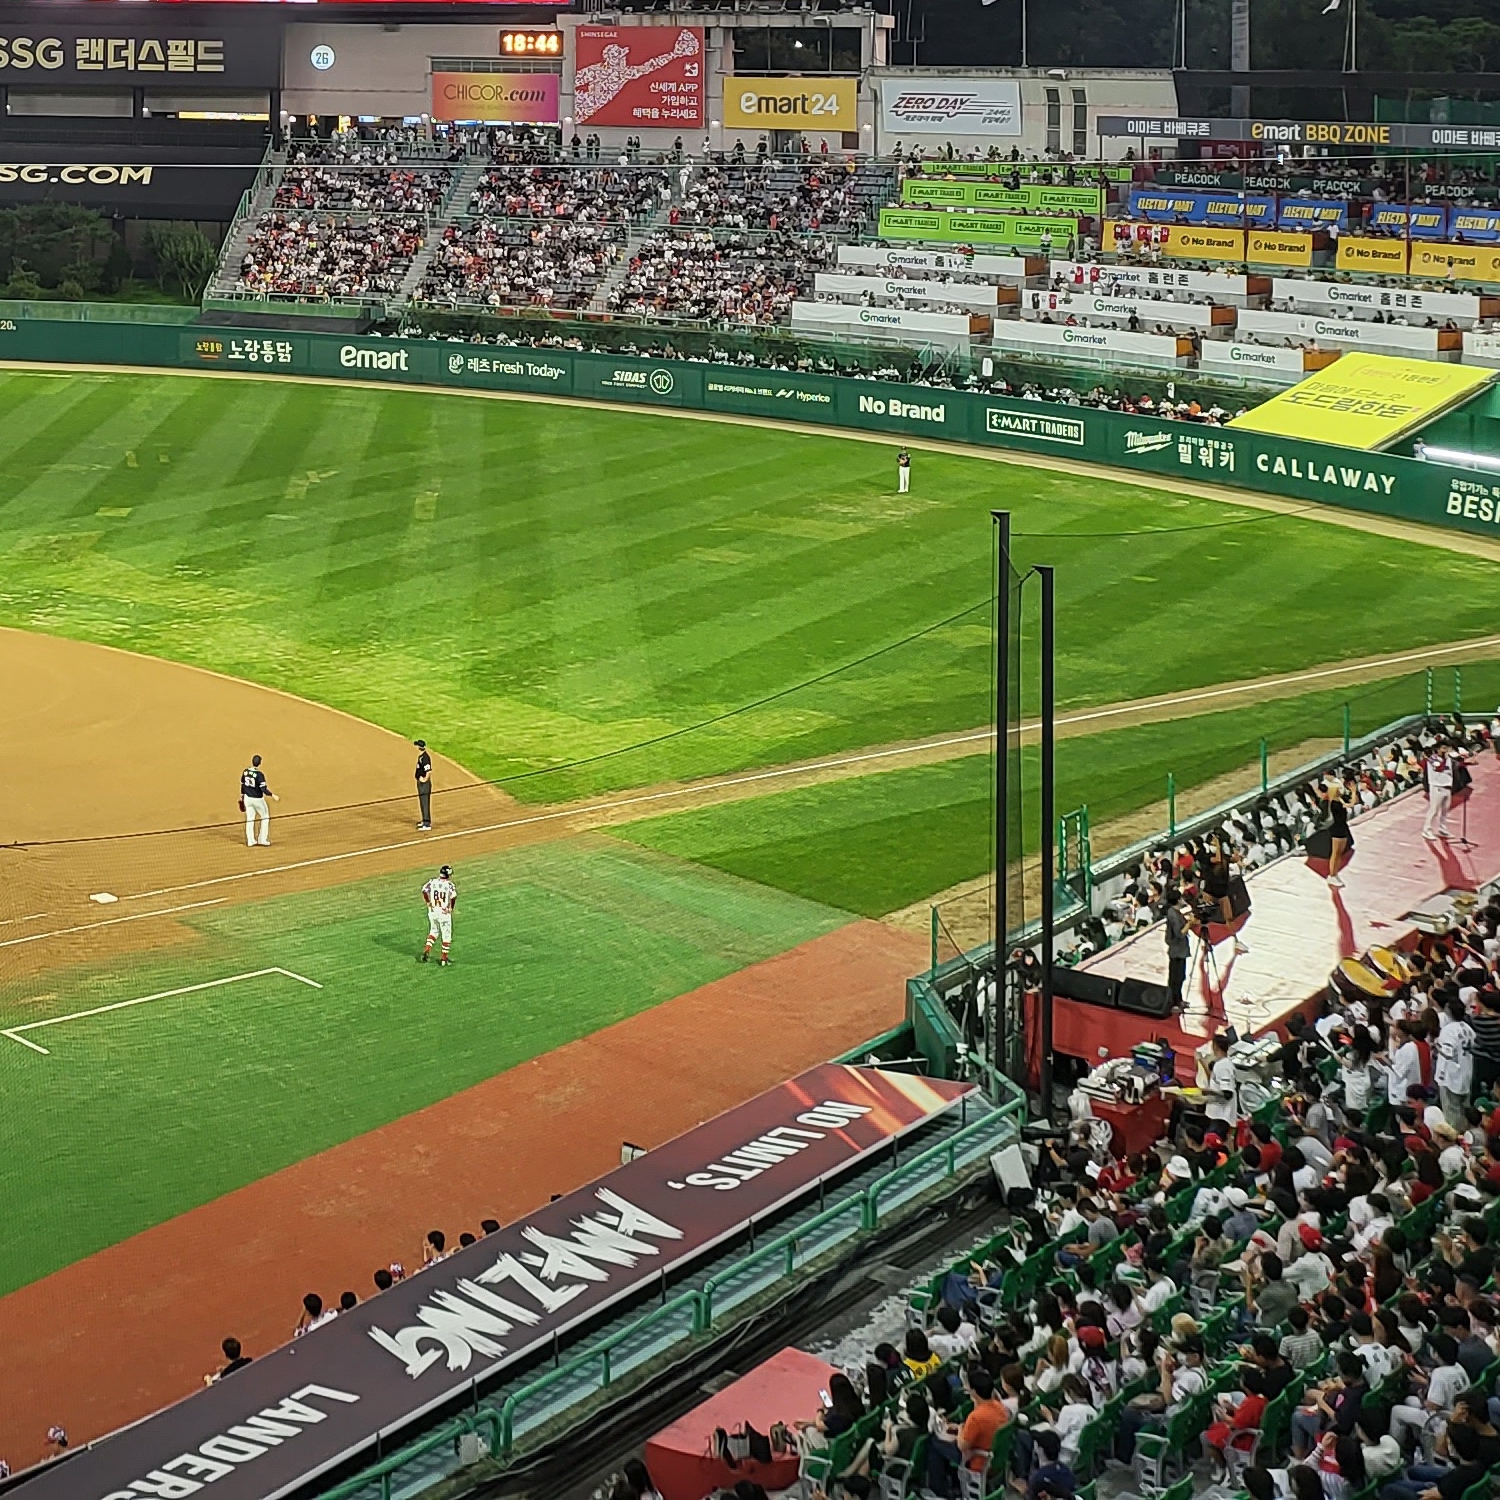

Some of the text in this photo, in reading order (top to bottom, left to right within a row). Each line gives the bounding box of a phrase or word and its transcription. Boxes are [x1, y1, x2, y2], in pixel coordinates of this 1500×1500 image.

[503, 33, 559, 53] 18:44
[75, 37, 225, 73] 랜더스필드
[315, 51, 330, 66] 26
[443, 83, 547, 103] CHICOR.com
[649, 82, 699, 93] 신세계 APP
[661, 95, 699, 107] 가입하고
[892, 96, 971, 110] ZERO DAY
[661, 108, 699, 119] 누리세요
[1127, 120, 1211, 136] 이마트 바베큐존
[1251, 122, 1391, 145] emart BBQ ZONE
[1432, 128, 1469, 145] 이마트
[1174, 172, 1221, 186] PEACOCK
[1425, 184, 1476, 198] PEACOCK
[1206, 238, 1235, 247] Brand
[1278, 243, 1306, 253] Brand
[886, 251, 928, 266] Gmarket
[1371, 249, 1401, 259] Brand
[1148, 271, 1190, 287] 홈런존
[885, 281, 927, 296] Gmarket
[1093, 298, 1138, 314] Gmarket
[1328, 286, 1423, 310] Gmarket 홈런존
[859, 309, 902, 325] Gmarket
[1062, 328, 1107, 345] Gmarket
[1314, 321, 1360, 339] Gmarket
[227, 339, 293, 363] 노랑통닭
[340, 345, 410, 372] emart
[1230, 346, 1276, 365] Gmarket
[467, 357, 491, 374] 레츠
[492, 360, 524, 375] Fresh
[612, 370, 647, 384] SIDAS
[796, 391, 831, 403] Hyperice
[1280, 391, 1414, 419] 도드람한돈
[859, 395, 946, 423] No Brand
[1039, 420, 1080, 440] TRADERS
[1177, 443, 1236, 472] 밀워키
[1255, 453, 1396, 495] CALLAWAY
[794, 1100, 873, 1132] NO
[667, 1123, 825, 1192] LIMITS,
[368, 1185, 686, 1379] AMAZING
